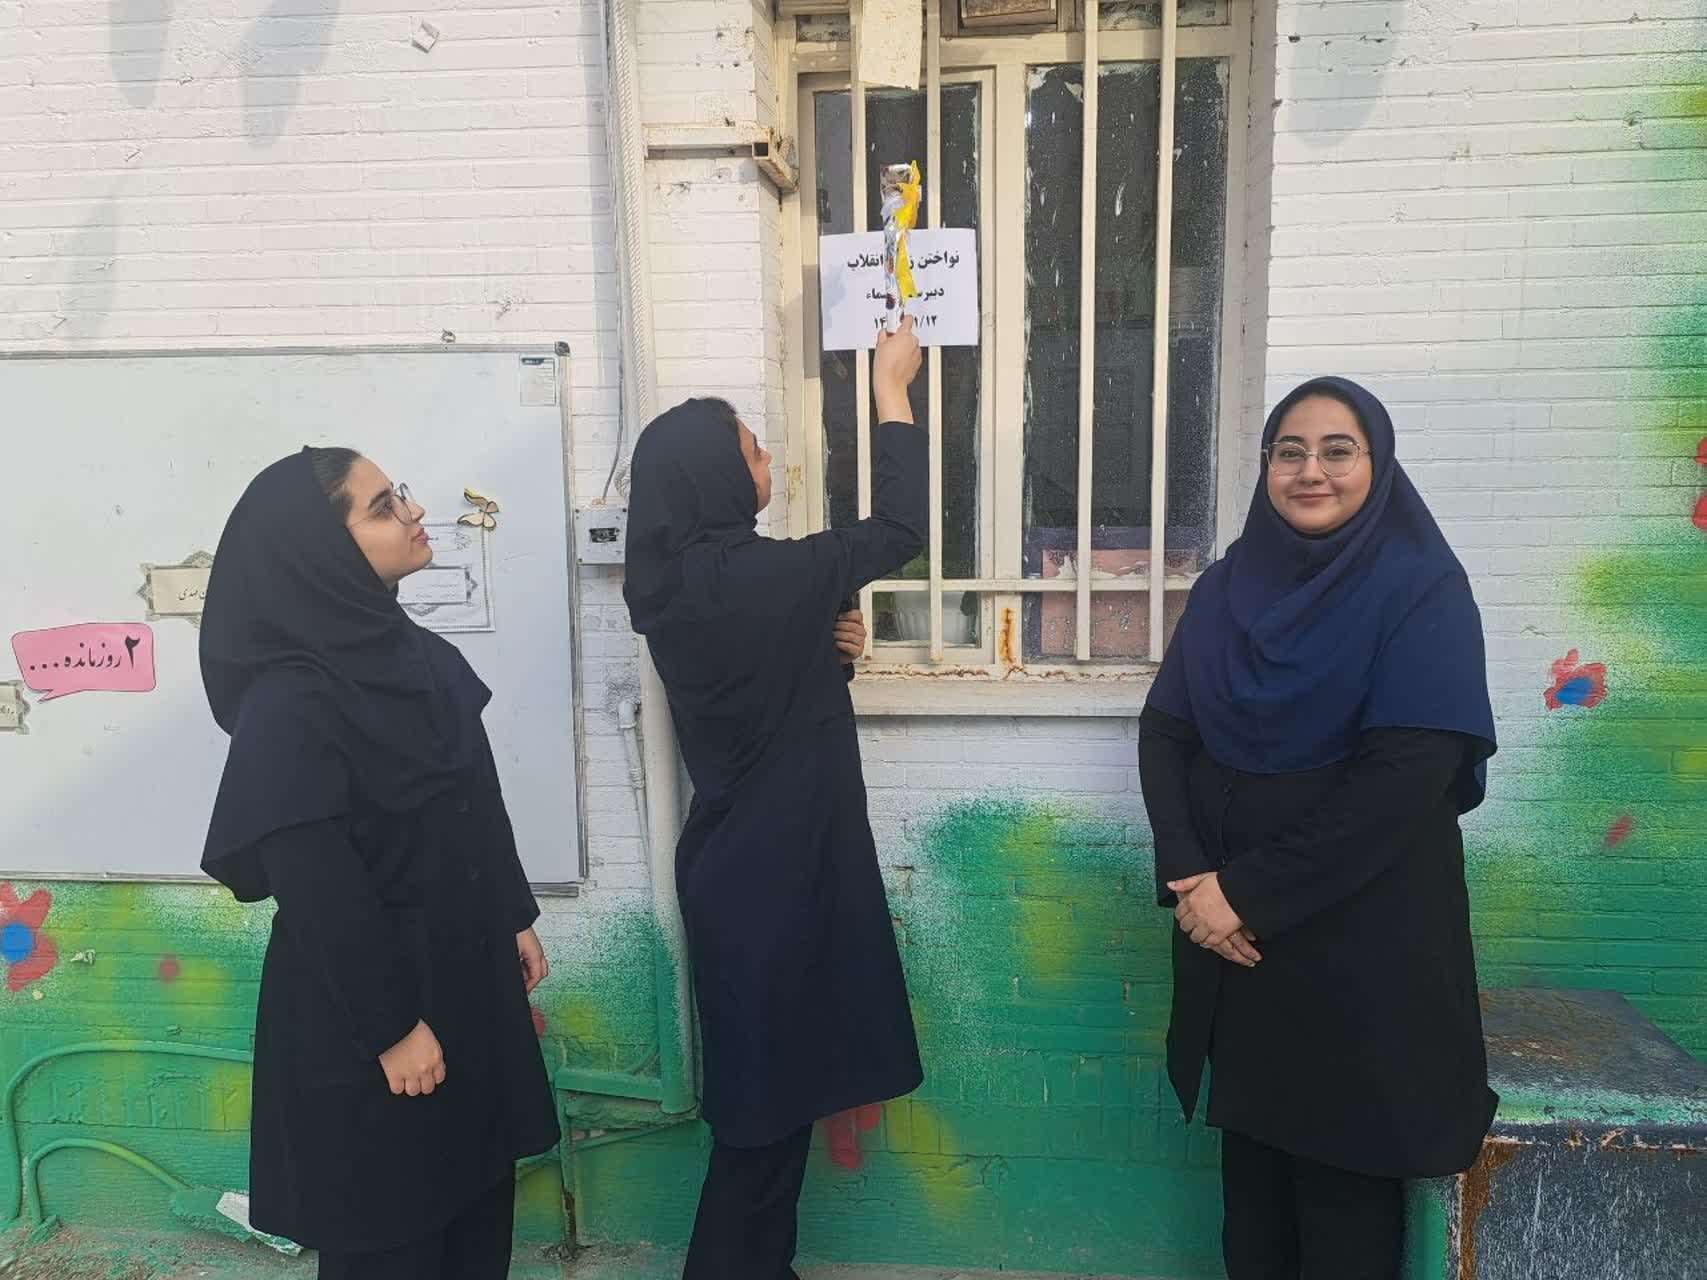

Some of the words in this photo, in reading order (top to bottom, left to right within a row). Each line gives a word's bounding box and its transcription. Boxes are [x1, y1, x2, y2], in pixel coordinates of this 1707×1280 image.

[847, 253, 884, 272] انقلاب
[918, 250, 960, 269] نواختن
[124, 635, 141, 669] ۲
